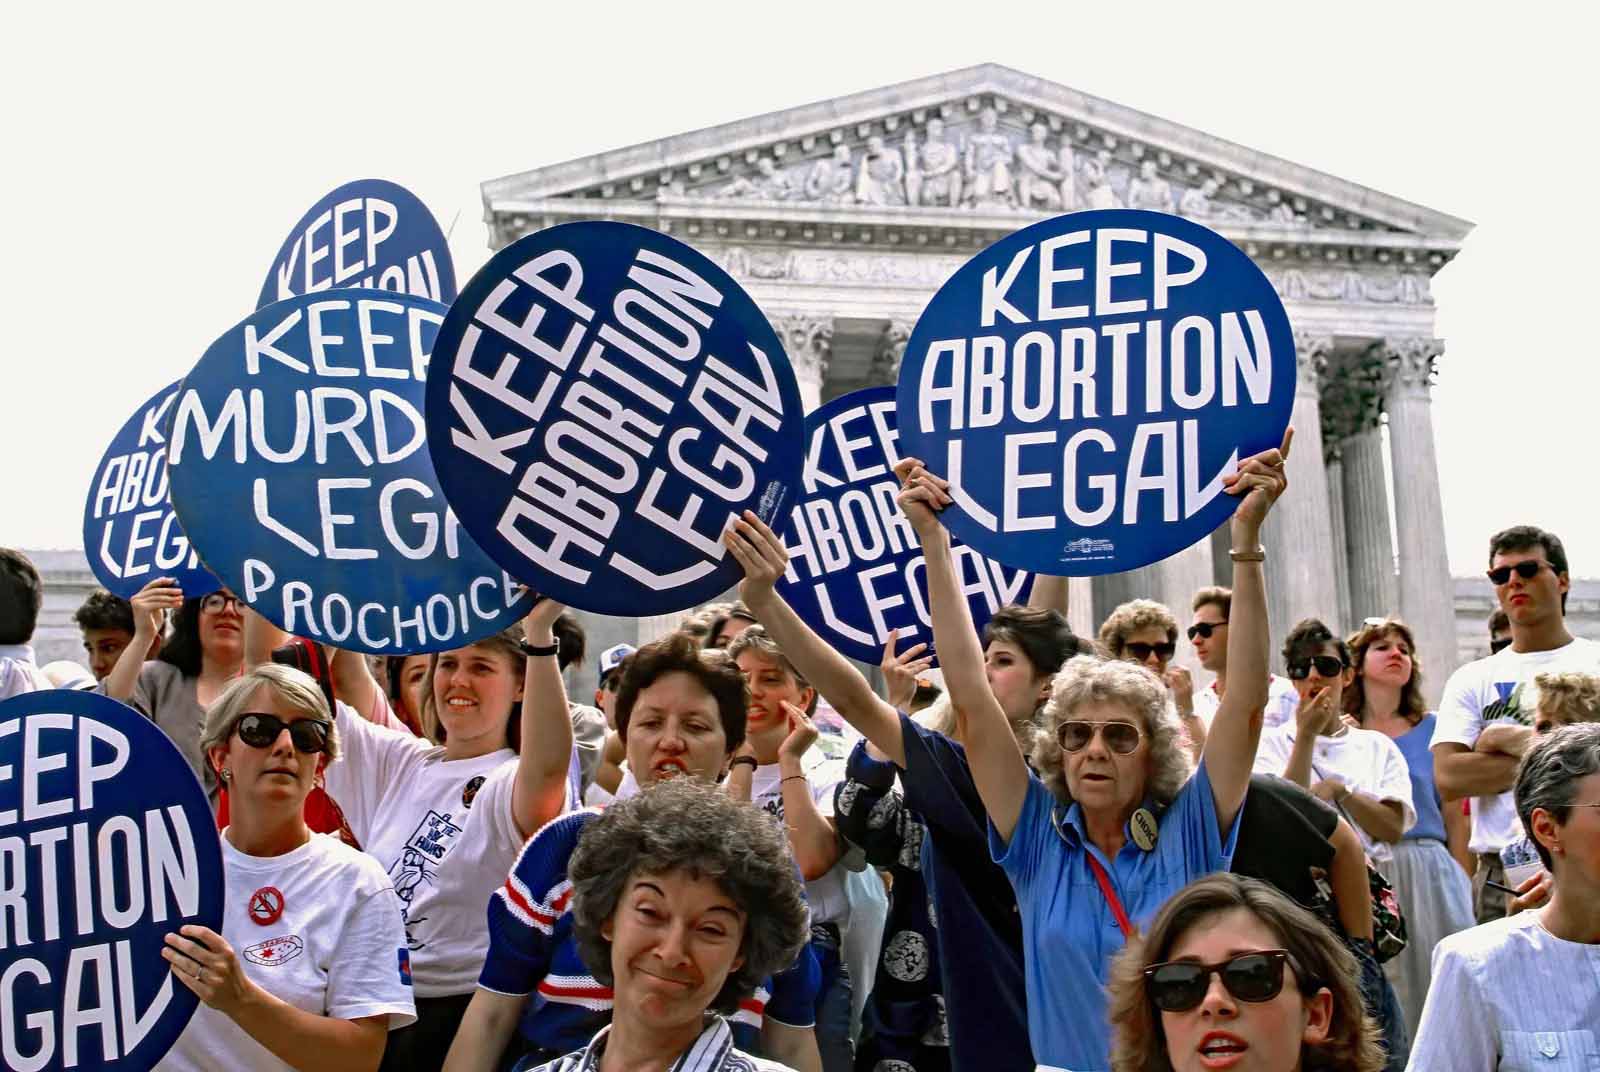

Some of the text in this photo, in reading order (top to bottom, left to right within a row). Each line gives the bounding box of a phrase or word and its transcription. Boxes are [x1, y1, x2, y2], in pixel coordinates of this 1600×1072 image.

[278, 198, 399, 302] KEEP
[981, 228, 1208, 327] KEEP
[449, 249, 596, 476] KEEP
[497, 248, 724, 585] ABORTION
[918, 310, 1272, 433] ABORTION
[608, 341, 784, 591] LEGAL
[947, 419, 1239, 533] LEGAL
